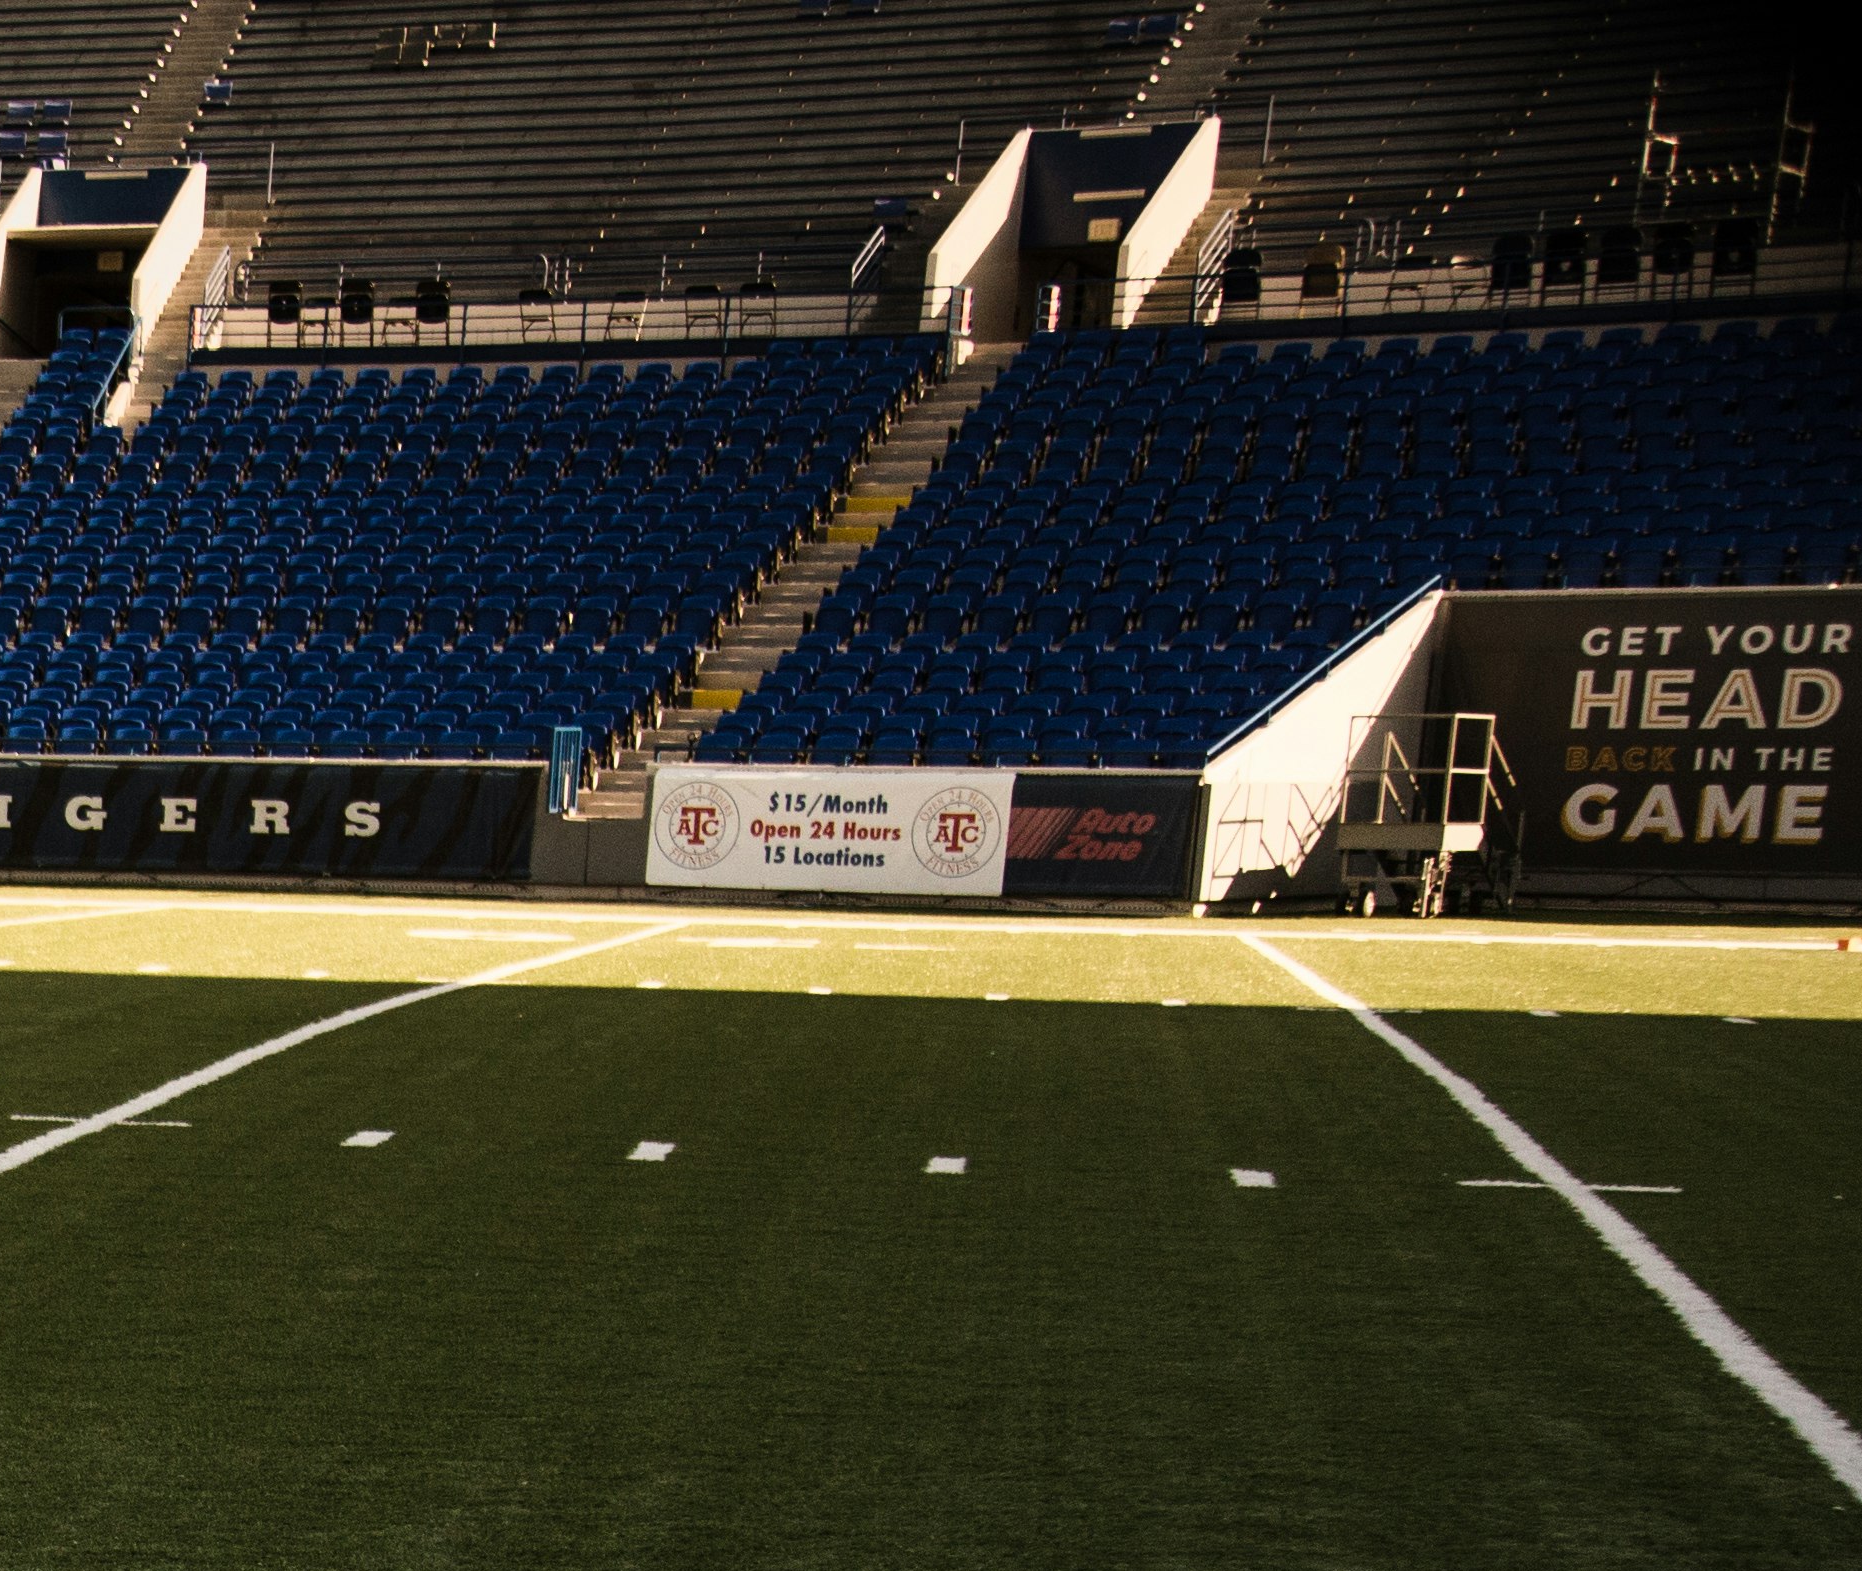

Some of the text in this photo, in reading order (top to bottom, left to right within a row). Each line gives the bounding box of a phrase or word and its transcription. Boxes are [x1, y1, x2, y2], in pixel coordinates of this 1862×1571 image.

[1581, 624, 1854, 656] GET YOUR
[1570, 668, 1843, 730] HEAD
[1565, 746, 1835, 772] BACK IN THE
[1561, 783, 1829, 845] GAME
[750, 819, 901, 843] Open 24 Hours
[764, 845, 885, 867] 15 Locations
